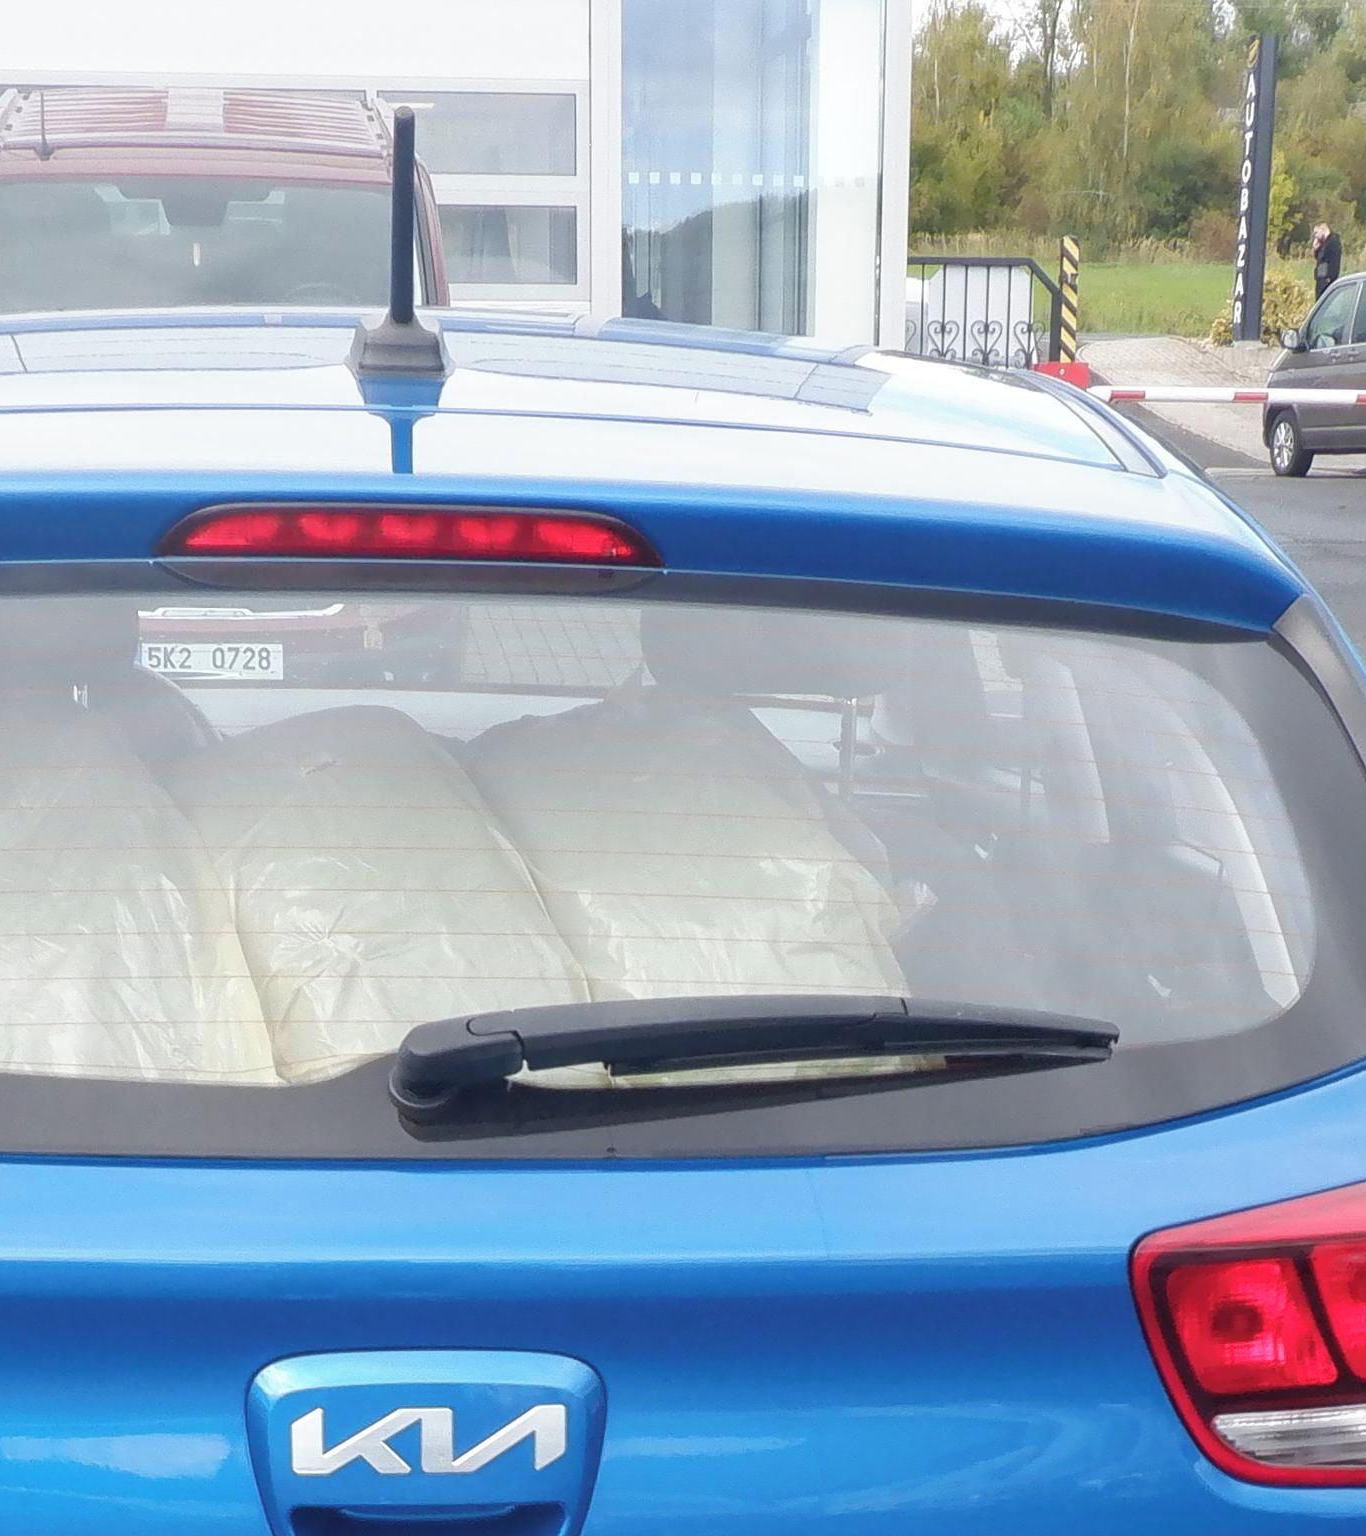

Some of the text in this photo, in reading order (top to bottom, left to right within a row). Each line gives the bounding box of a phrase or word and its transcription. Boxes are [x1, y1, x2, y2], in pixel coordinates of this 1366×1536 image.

[1233, 72, 1256, 324] AUTOBAZAR
[148, 647, 271, 670] 5K2 0728
[291, 1404, 566, 1474] KIA
